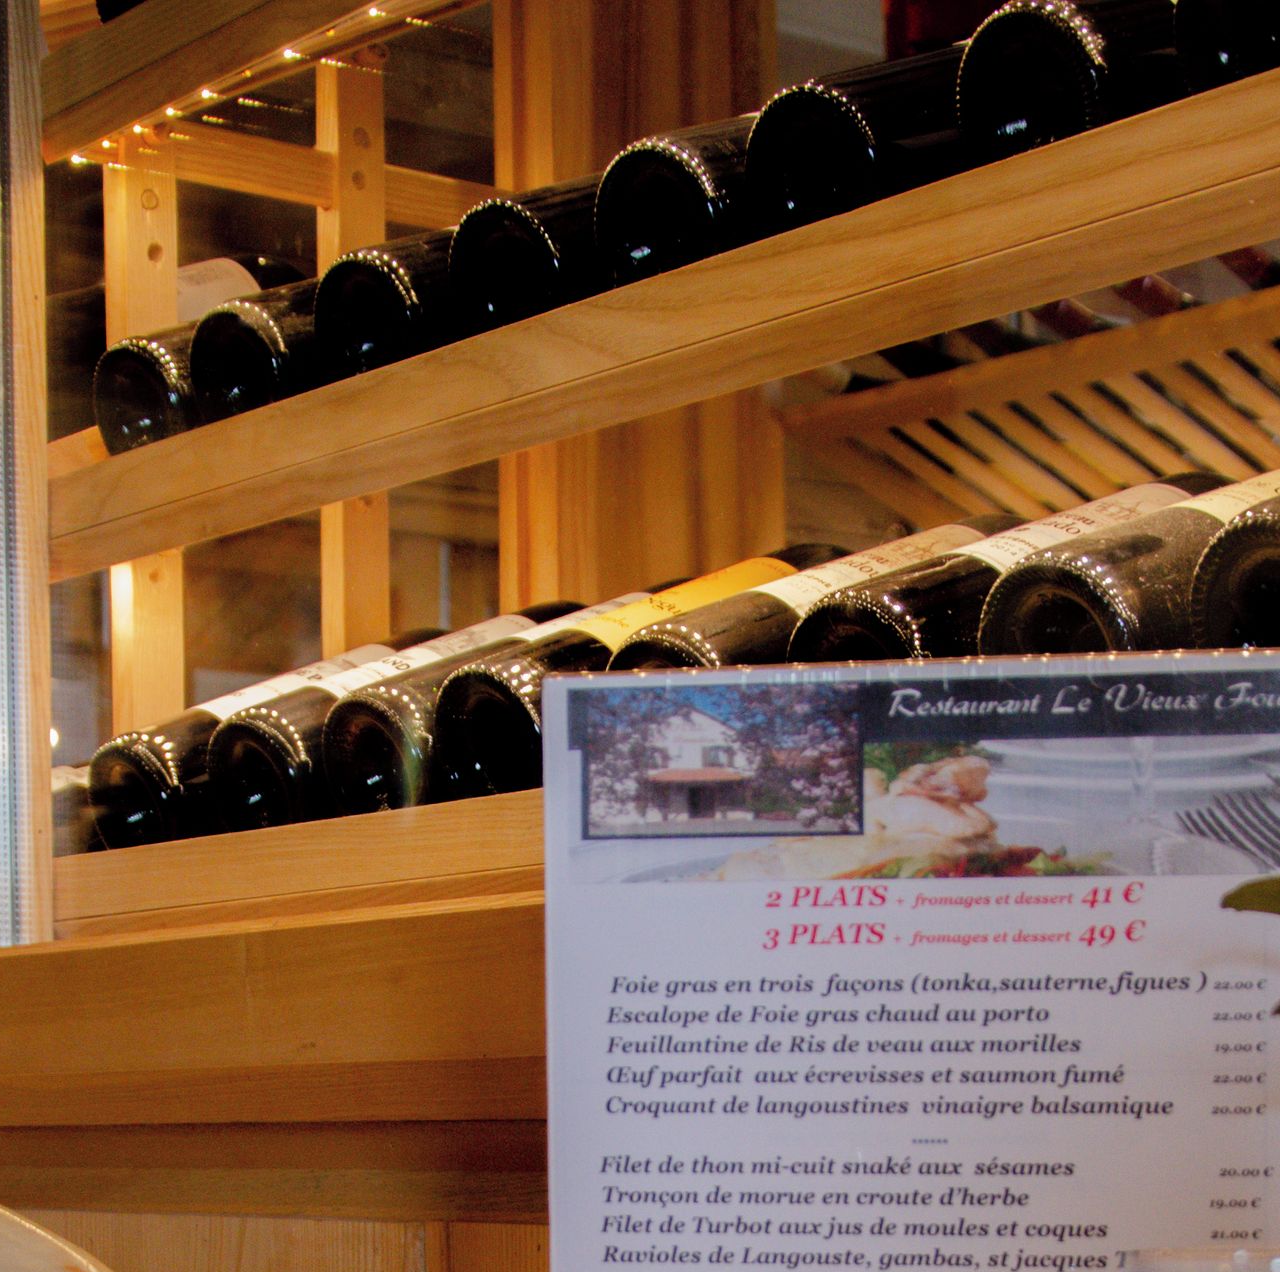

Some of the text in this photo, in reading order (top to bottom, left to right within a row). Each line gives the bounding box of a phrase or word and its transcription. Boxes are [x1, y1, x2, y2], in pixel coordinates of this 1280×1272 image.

[887, 688, 1043, 718] Restaurant
[1050, 684, 1092, 715] Le
[1104, 682, 1201, 712] Vieux
[764, 881, 1146, 910] 2 PLATS fromages et dessert 41 €
[761, 919, 1148, 952] 3 PLATS fromages et dessert 49 €
[609, 974, 660, 995] Foie
[664, 979, 719, 999] gras
[723, 979, 753, 994] en
[758, 973, 815, 994] trois
[820, 972, 905, 998] façons
[605, 1004, 710, 1029] Escalope
[714, 1003, 744, 1024] de
[748, 1003, 800, 1024] Foie
[804, 1009, 860, 1028] gras
[864, 1002, 941, 1024] chaud
[945, 1008, 977, 1023] au
[981, 1005, 1051, 1028] porto
[605, 1034, 749, 1055] Feuillantine
[754, 1033, 783, 1054] de
[787, 1034, 827, 1054] Ris
[831, 1033, 861, 1054] de
[866, 1039, 924, 1054] veau
[929, 1039, 976, 1054] aux
[980, 1032, 1083, 1054] morilles
[605, 1064, 660, 1089] Œuf
[658, 1064, 743, 1089] parfait
[753, 1070, 799, 1085] aux
[803, 1064, 925, 1084] écrevisses
[930, 1066, 955, 1084] et
[958, 1070, 1057, 1084] saumon
[1056, 1063, 1126, 1089] fumé
[604, 1095, 718, 1120] Croquant
[721, 1094, 750, 1115] de
[755, 1094, 910, 1120] langoustines
[921, 1094, 1025, 1120] vinaigre
[1029, 1094, 1175, 1121] balsamique
[599, 1154, 653, 1175] Filet
[657, 1154, 685, 1175] de
[690, 1154, 745, 1175] thon
[750, 1155, 837, 1176] mi-cuit
[840, 1155, 912, 1177] snaké
[917, 1161, 964, 1176] aux
[973, 1156, 1076, 1178] sésames
[601, 1185, 699, 1209] Tronçon
[704, 1184, 733, 1205] de
[738, 1191, 816, 1206] morue
[821, 1191, 850, 1206] en
[855, 1189, 934, 1207] croute
[938, 1186, 1030, 1207] d'herbe
[600, 1214, 654, 1235] Filet
[658, 1214, 686, 1235] de
[691, 1215, 773, 1235] Turbot
[777, 1221, 823, 1236] aux
[822, 1216, 864, 1241] jus
[868, 1216, 898, 1237] de
[903, 1217, 990, 1238] moules
[995, 1220, 1020, 1238] et
[1023, 1223, 1109, 1243] coques
[601, 1244, 702, 1265] Ravioles
[706, 1244, 735, 1265] de
[740, 1246, 872, 1271] Langouste,
[877, 1247, 981, 1272] gambas,
[986, 1251, 1010, 1268] st
